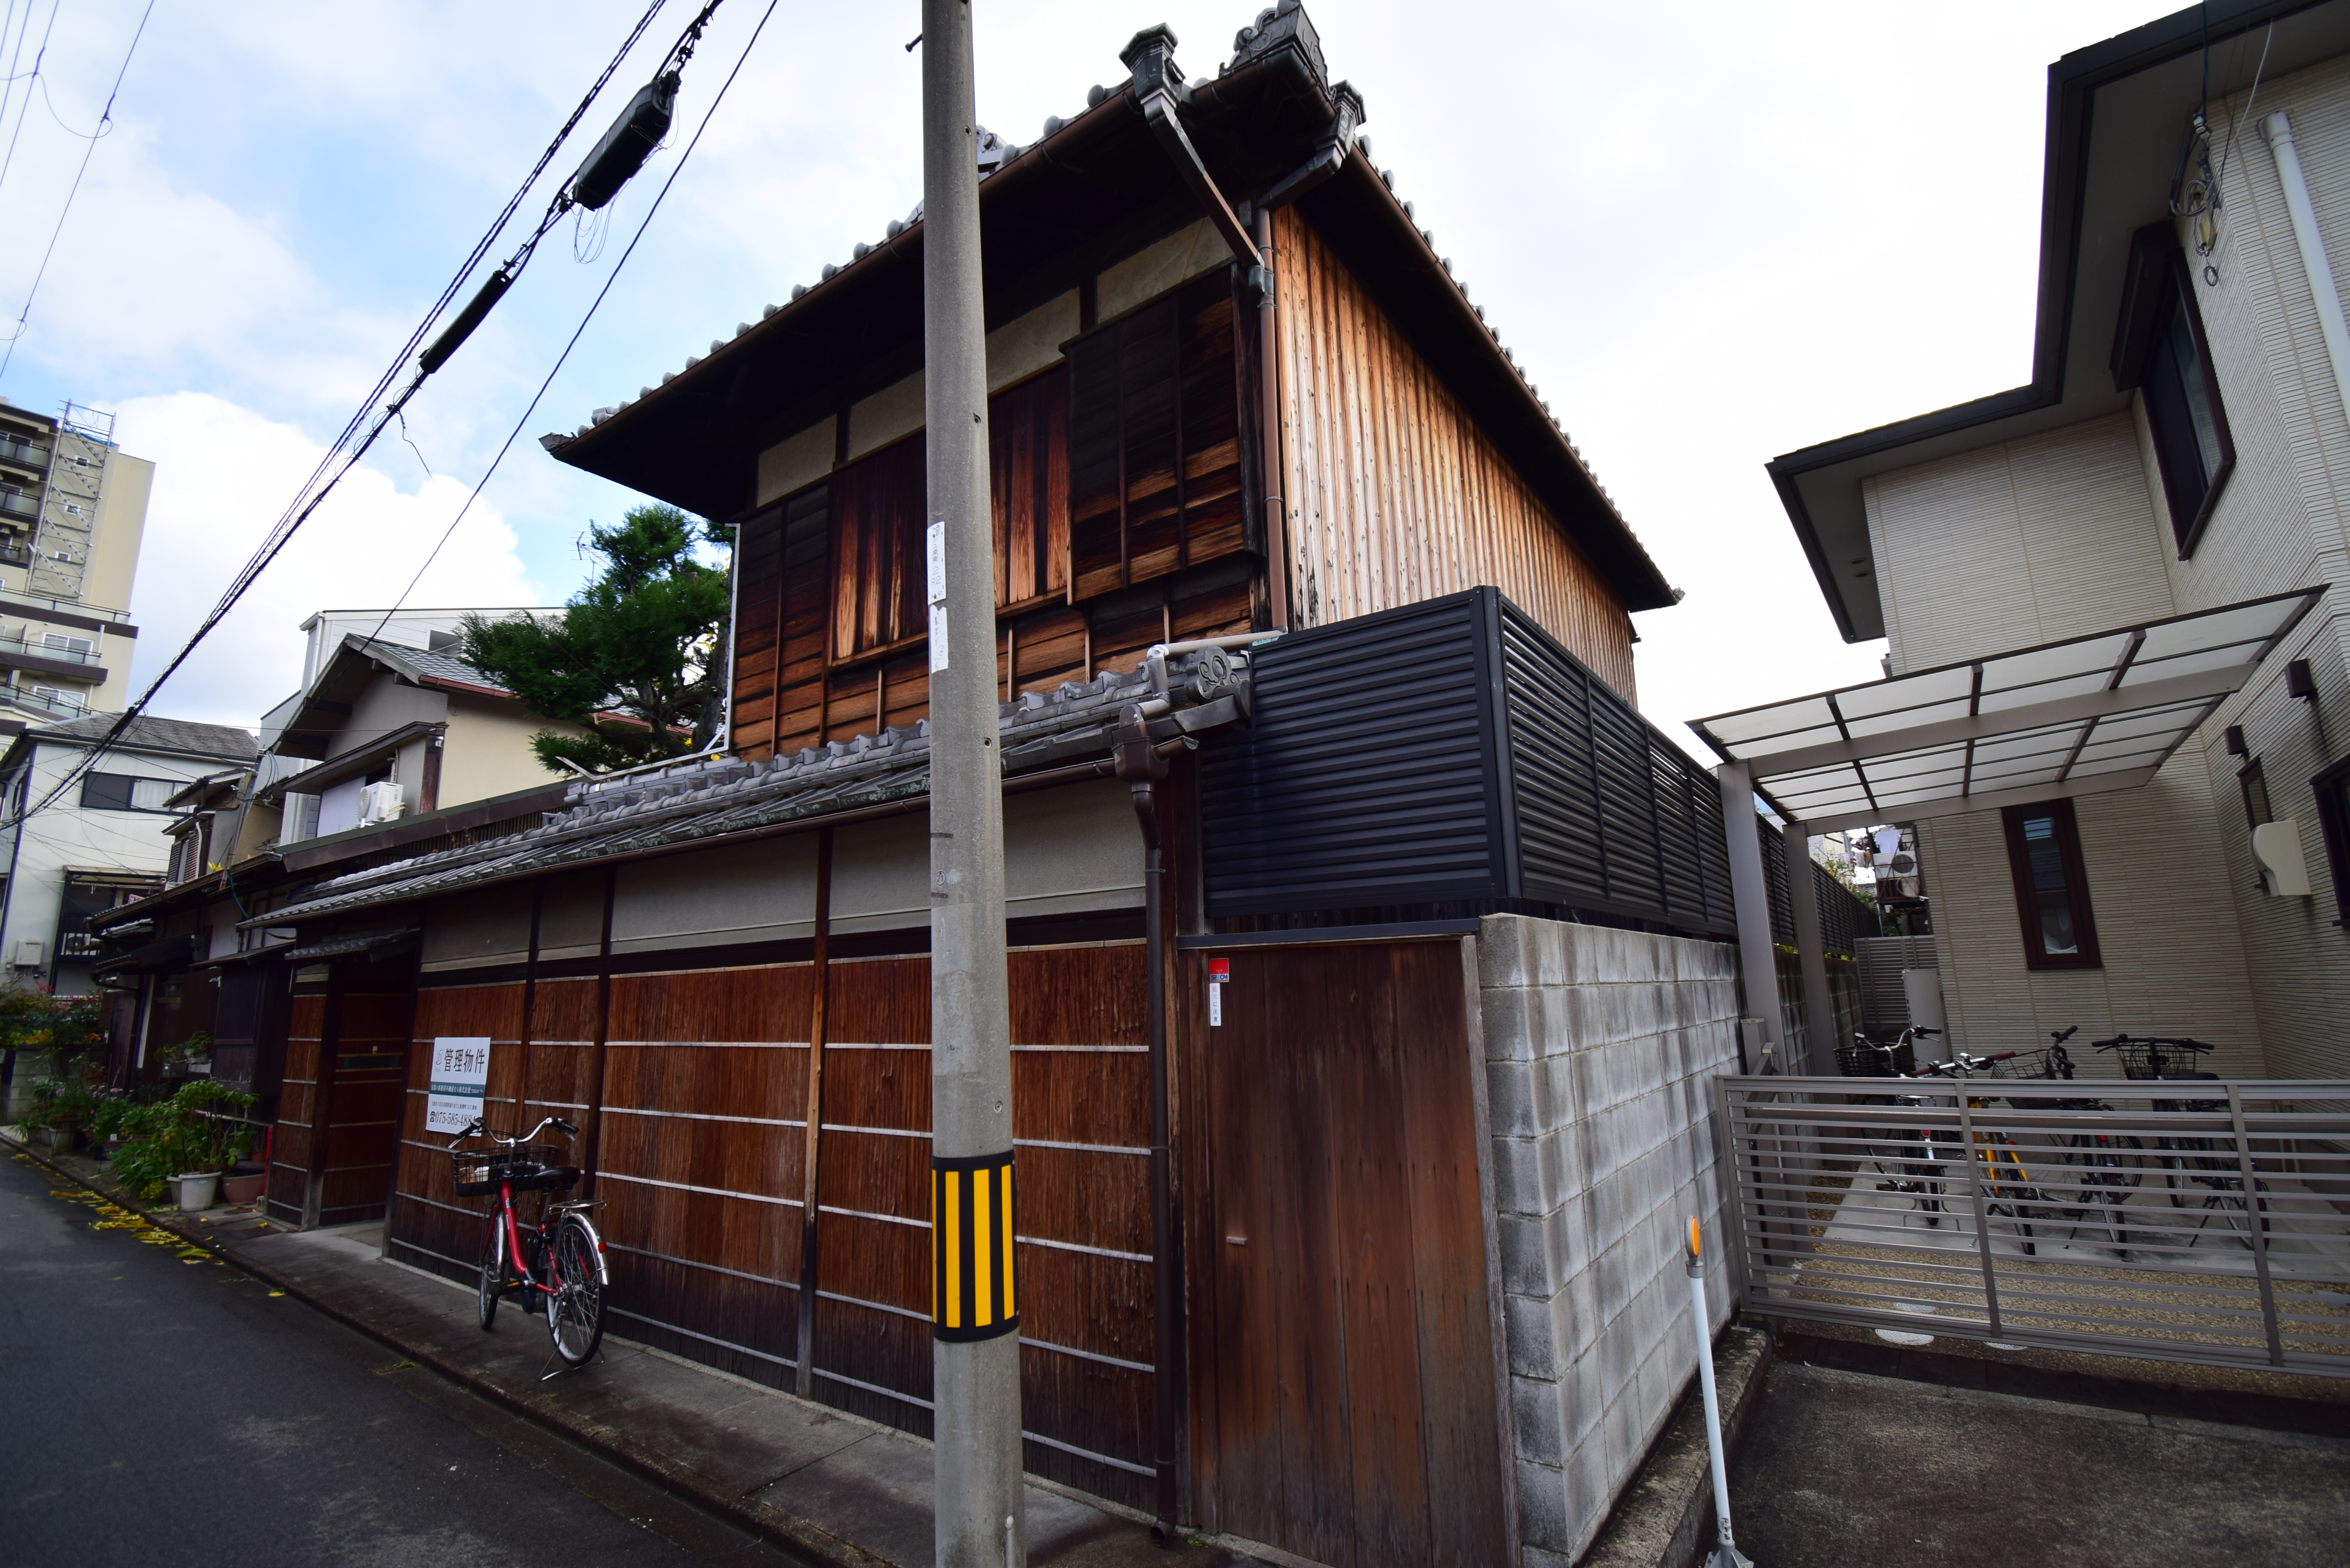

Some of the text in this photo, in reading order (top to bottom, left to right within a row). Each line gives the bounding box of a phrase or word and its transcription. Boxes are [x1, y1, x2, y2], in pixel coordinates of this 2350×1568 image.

[444, 1048, 485, 1074] 管理物件
[435, 1111, 476, 1126] 075-585-488
